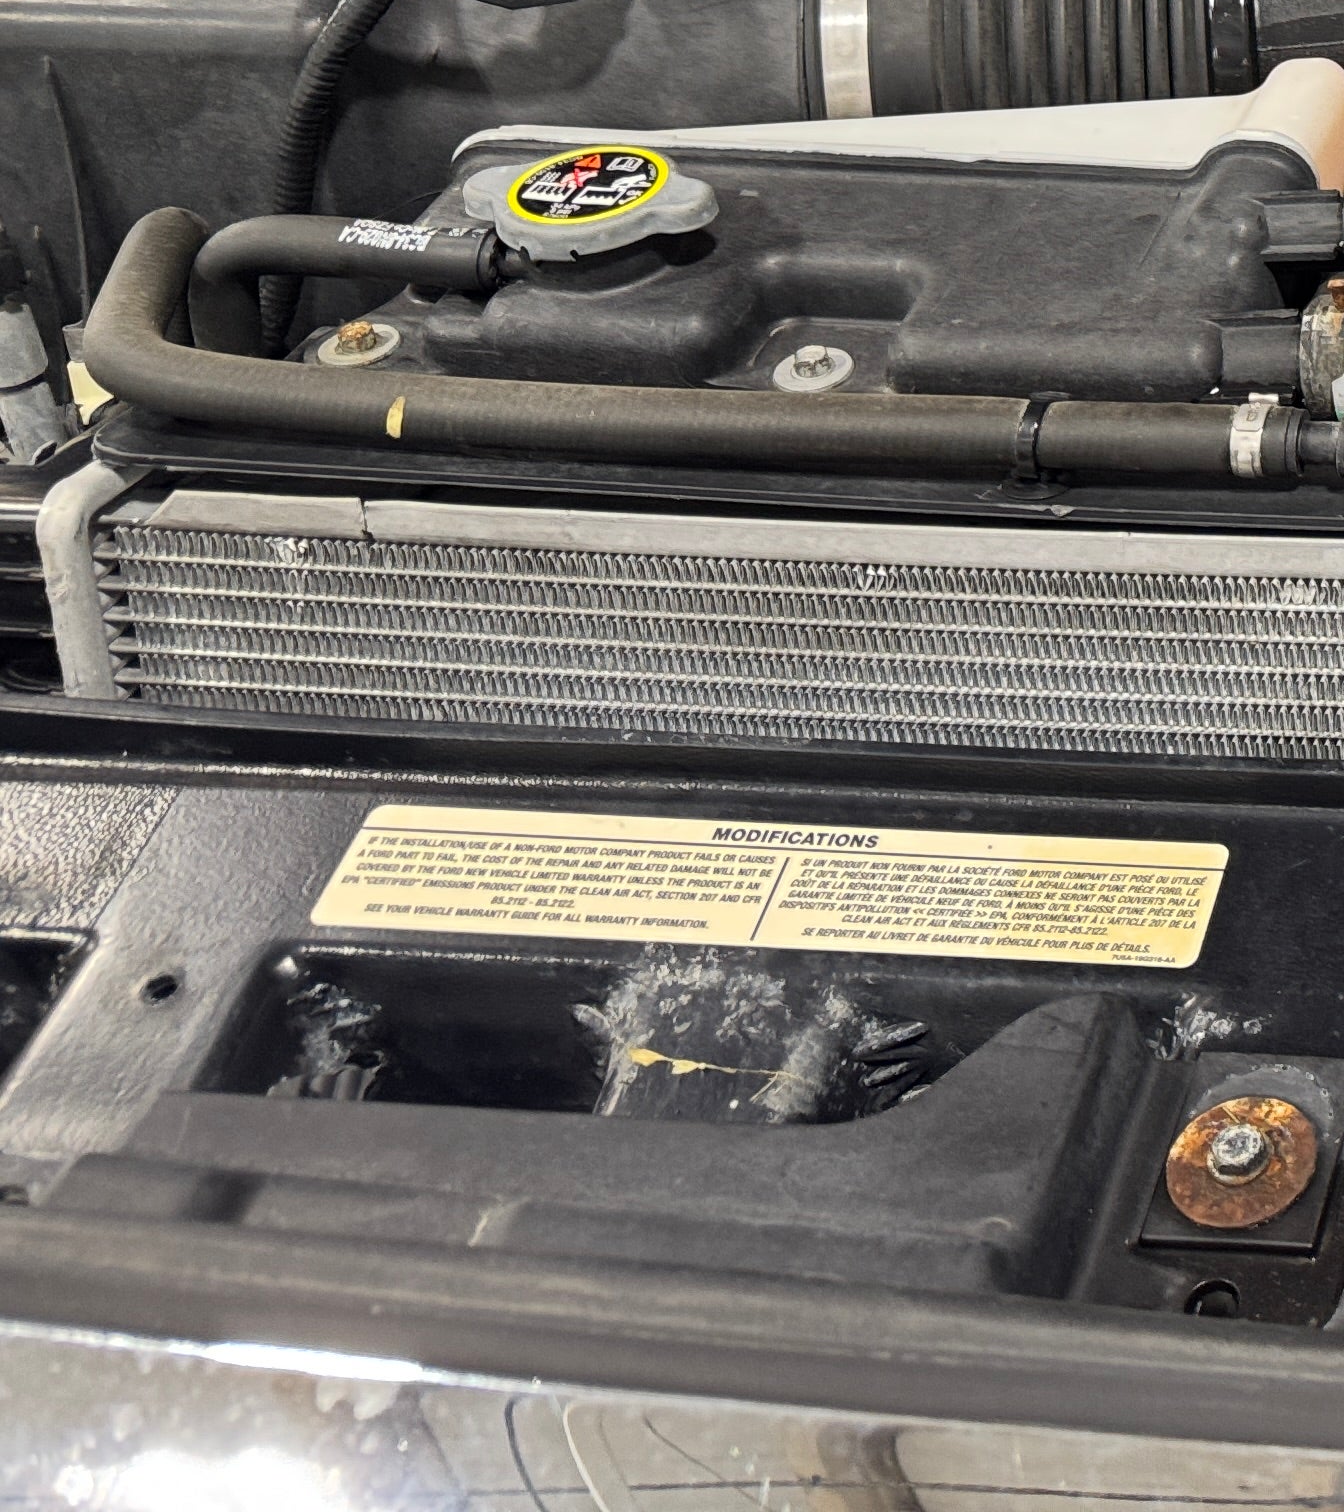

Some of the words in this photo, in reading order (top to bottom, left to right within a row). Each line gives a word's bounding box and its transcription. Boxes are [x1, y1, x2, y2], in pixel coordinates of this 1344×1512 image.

[367, 836, 379, 844] IF
[379, 836, 400, 845] THE
[488, 842, 503, 850] OF
[512, 843, 563, 853] NON-FORD
[562, 845, 598, 855] MOTOR
[598, 847, 646, 857] COMPANY
[646, 849, 692, 859] PRODUCT
[692, 852, 721, 861] FAILS
[721, 853, 737, 862] OR
[737, 854, 776, 864] CAUSES
[711, 827, 880, 849] MODIFICATIONS
[355, 862, 401, 872] COVERED
[400, 864, 416, 873] BY
[415, 865, 436, 874] THE
[436, 866, 464, 875] FORD
[463, 867, 488, 876] NEW
[488, 869, 529, 878] VEHICLE
[529, 871, 570, 880] LIMITED
[570, 873, 625, 883] WARRANTY
[625, 875, 665, 885] UNLESS
[665, 877, 686, 886] THE
[685, 878, 732, 888] PRODUCT
[732, 881, 745, 889] IS
[745, 881, 761, 890] AN
[365, 849, 394, 859] FORD
[393, 851, 420, 860] PART
[420, 852, 435, 861] TO
[460, 854, 481, 863] THE
[480, 855, 508, 864] COST
[508, 856, 524, 865] OF
[523, 857, 544, 866] THE
[543, 858, 580, 868] REPAIR
[580, 860, 603, 869] AND
[602, 861, 624, 870] ANY
[624, 862, 669, 872] RELATED
[668, 864, 711, 874] DAMAGE
[711, 866, 736, 875] WILL
[736, 867, 757, 877] NOT
[758, 868, 773, 877] BE
[800, 857, 813, 866] SI
[811, 858, 828, 867] UN
[826, 859, 869, 869] PRODUIT
[868, 861, 892, 870] NON
[890, 862, 927, 872] FOURNI
[925, 864, 948, 873] PAR
[945, 865, 962, 873] LA
[960, 865, 1002, 875] SOCIÉTÉ
[1000, 867, 1029, 877] FORD
[1027, 868, 1063, 878] MOTOR
[1061, 870, 1109, 881] COMPANY
[1108, 872, 1129, 882] EST
[1127, 873, 1155, 883] POSÉ
[1154, 875, 1171, 884] OU
[1169, 875, 1207, 885] UTILISÉ
[340, 875, 361, 884] EPA
[420, 879, 476, 889] EMISSIONS
[475, 881, 522, 892] PRODUCT
[521, 884, 557, 893] UNDER
[557, 886, 578, 895] THE
[577, 887, 612, 896] CLEAN
[612, 888, 631, 897] AIR
[654, 890, 698, 901] SECTION
[697, 893, 718, 902] 207
[718, 894, 741, 903] AND
[740, 895, 762, 904] CFR
[363, 903, 384, 912] SEE
[384, 904, 412, 913] YOUR
[411, 906, 453, 916] VEHICLE
[453, 908, 509, 918] WARRANTY
[509, 911, 541, 920] GUIDE
[540, 912, 562, 921] FOR
[562, 913, 582, 922] ALL
[583, 914, 639, 925] WARRANTY
[639, 917, 711, 929] INFORMATION.
